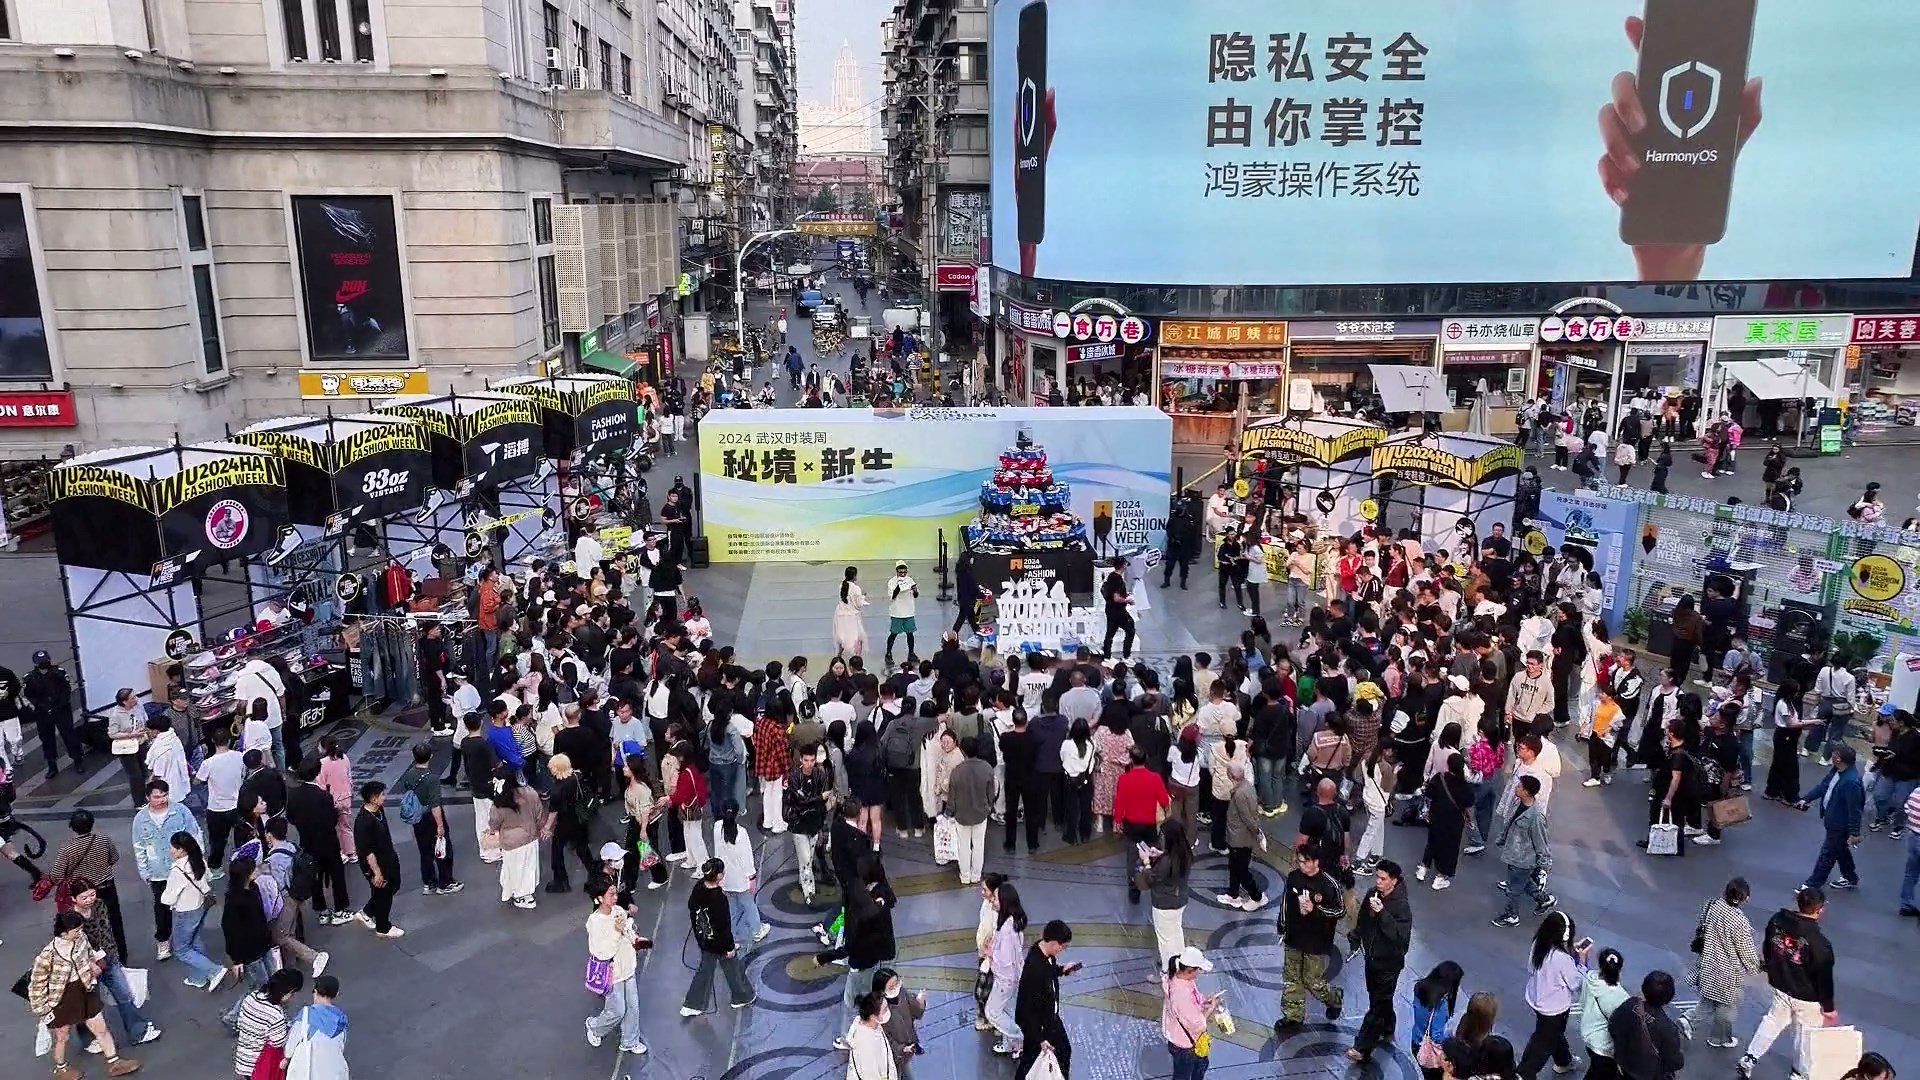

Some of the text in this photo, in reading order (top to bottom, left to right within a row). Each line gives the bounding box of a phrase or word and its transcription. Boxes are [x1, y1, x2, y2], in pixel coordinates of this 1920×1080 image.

[1208, 31, 1430, 83] 隐私安全
[1206, 97, 1425, 148] 由你掌控
[1645, 150, 1719, 165] HarmonyOS
[1203, 161, 1422, 198] 鸿蒙操作系统
[341, 280, 368, 292] RUN
[1056, 318, 1140, 340] 一食万巷
[1187, 325, 1261, 340] 江城阿姨
[1335, 321, 1395, 334] 爷爷不泡茶
[1465, 323, 1535, 339] 书亦烧仙草
[1543, 320, 1633, 338] 一食万巷
[1745, 320, 1820, 344] 真茶屋
[22, 404, 60, 417] 意尔康
[480, 413, 529, 432] FASHION WEEK
[591, 412, 628, 431] FASHION
[591, 429, 608, 443] LAB
[718, 431, 828, 445] 2024 武汉时装周
[287, 449, 312, 464] WEEK
[353, 438, 416, 462] FASHION WEEK
[503, 438, 530, 460] 滔博
[1260, 440, 1316, 457] FASHION WEEK
[1391, 458, 1455, 477] FASHION WEEK
[66, 484, 136, 504] FASHION WEEK
[184, 471, 266, 500] FASHION WEEK
[369, 485, 405, 499] VINTAGE
[1116, 500, 1140, 509] 2024
[1115, 509, 1145, 518] WUHAN
[1114, 518, 1167, 531] FASHION
[1115, 532, 1149, 544] WEEK
[1656, 550, 1682, 561] WEEK
[1001, 580, 1067, 600] 2024
[998, 599, 1070, 619] WUHAN
